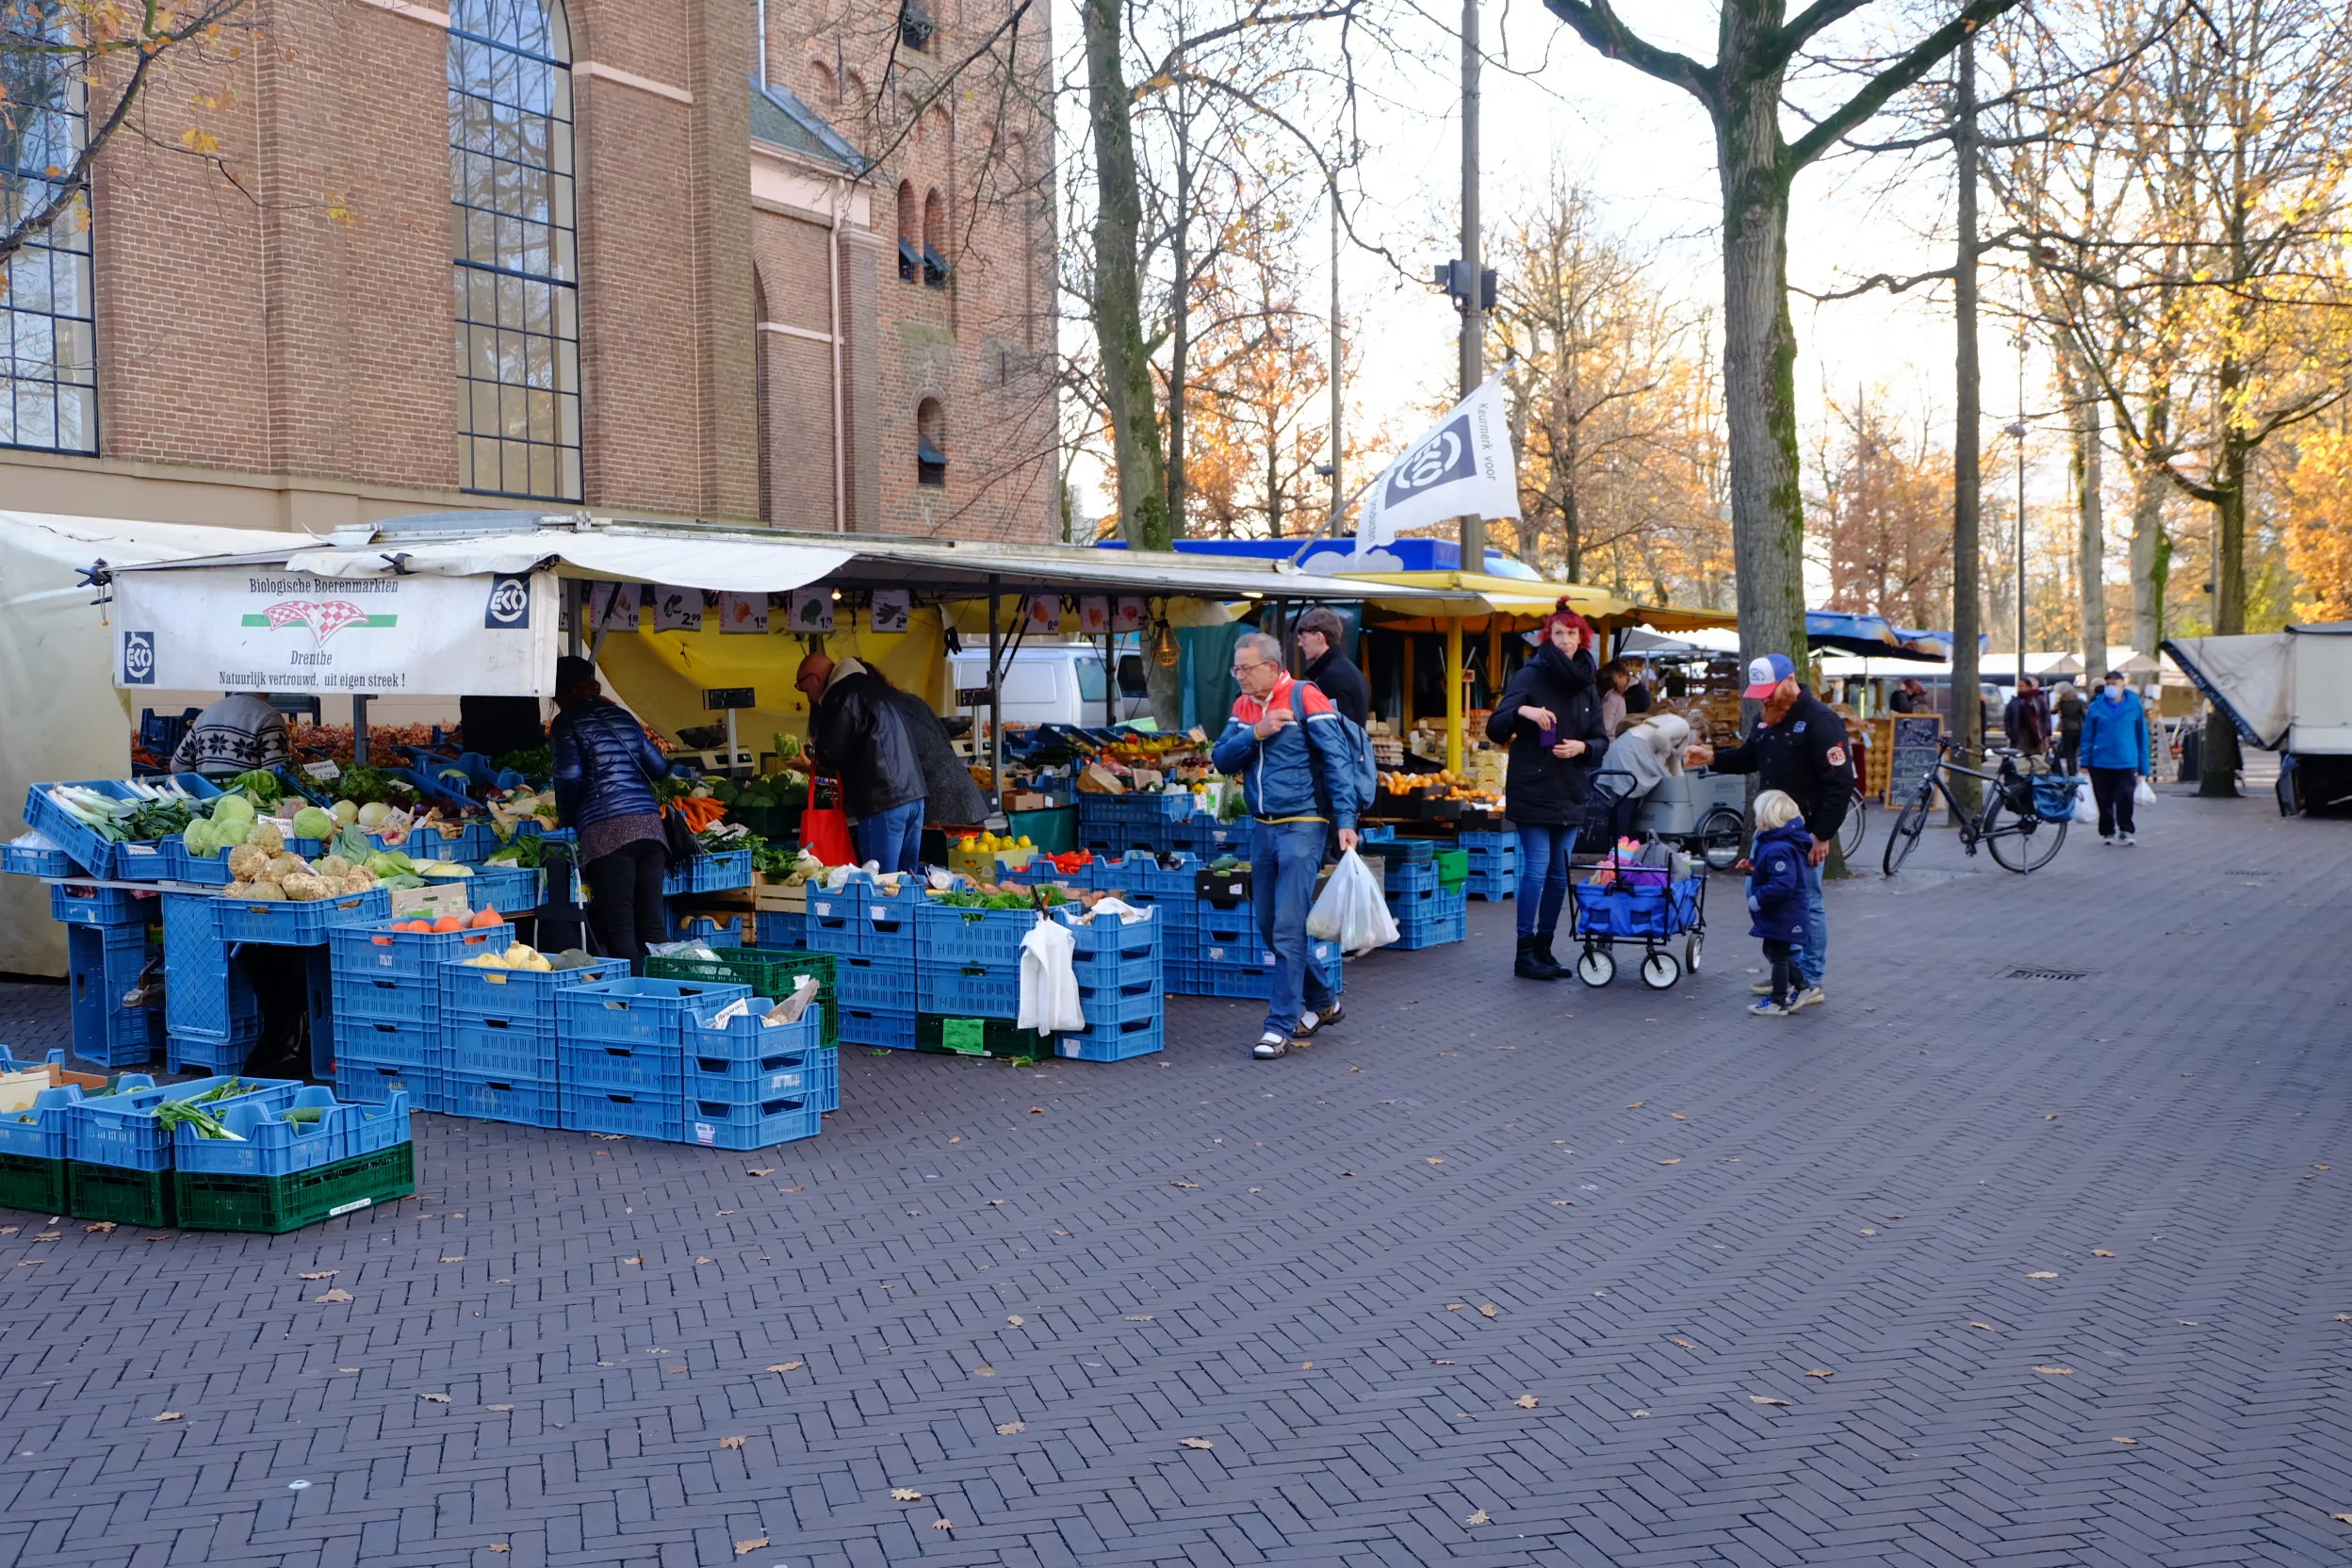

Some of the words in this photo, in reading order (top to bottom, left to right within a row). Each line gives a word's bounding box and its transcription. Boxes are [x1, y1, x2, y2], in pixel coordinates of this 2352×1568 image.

[1478, 402, 1493, 450] Keurmerk
[1483, 455, 1495, 481] voor
[249, 578, 311, 596] Biologische
[314, 579, 399, 594] Boerenmarkten
[490, 589, 527, 612] EKO
[681, 612, 701, 626] 2.99
[126, 647, 153, 668] EKO
[290, 650, 333, 665] Drenthe
[219, 671, 266, 688] Natuurlijk
[270, 672, 319, 688] vertrouwd,
[324, 673, 337, 686] uit
[339, 674, 366, 690] eigen
[368, 672, 399, 687] streek
[401, 672, 406, 687] !
